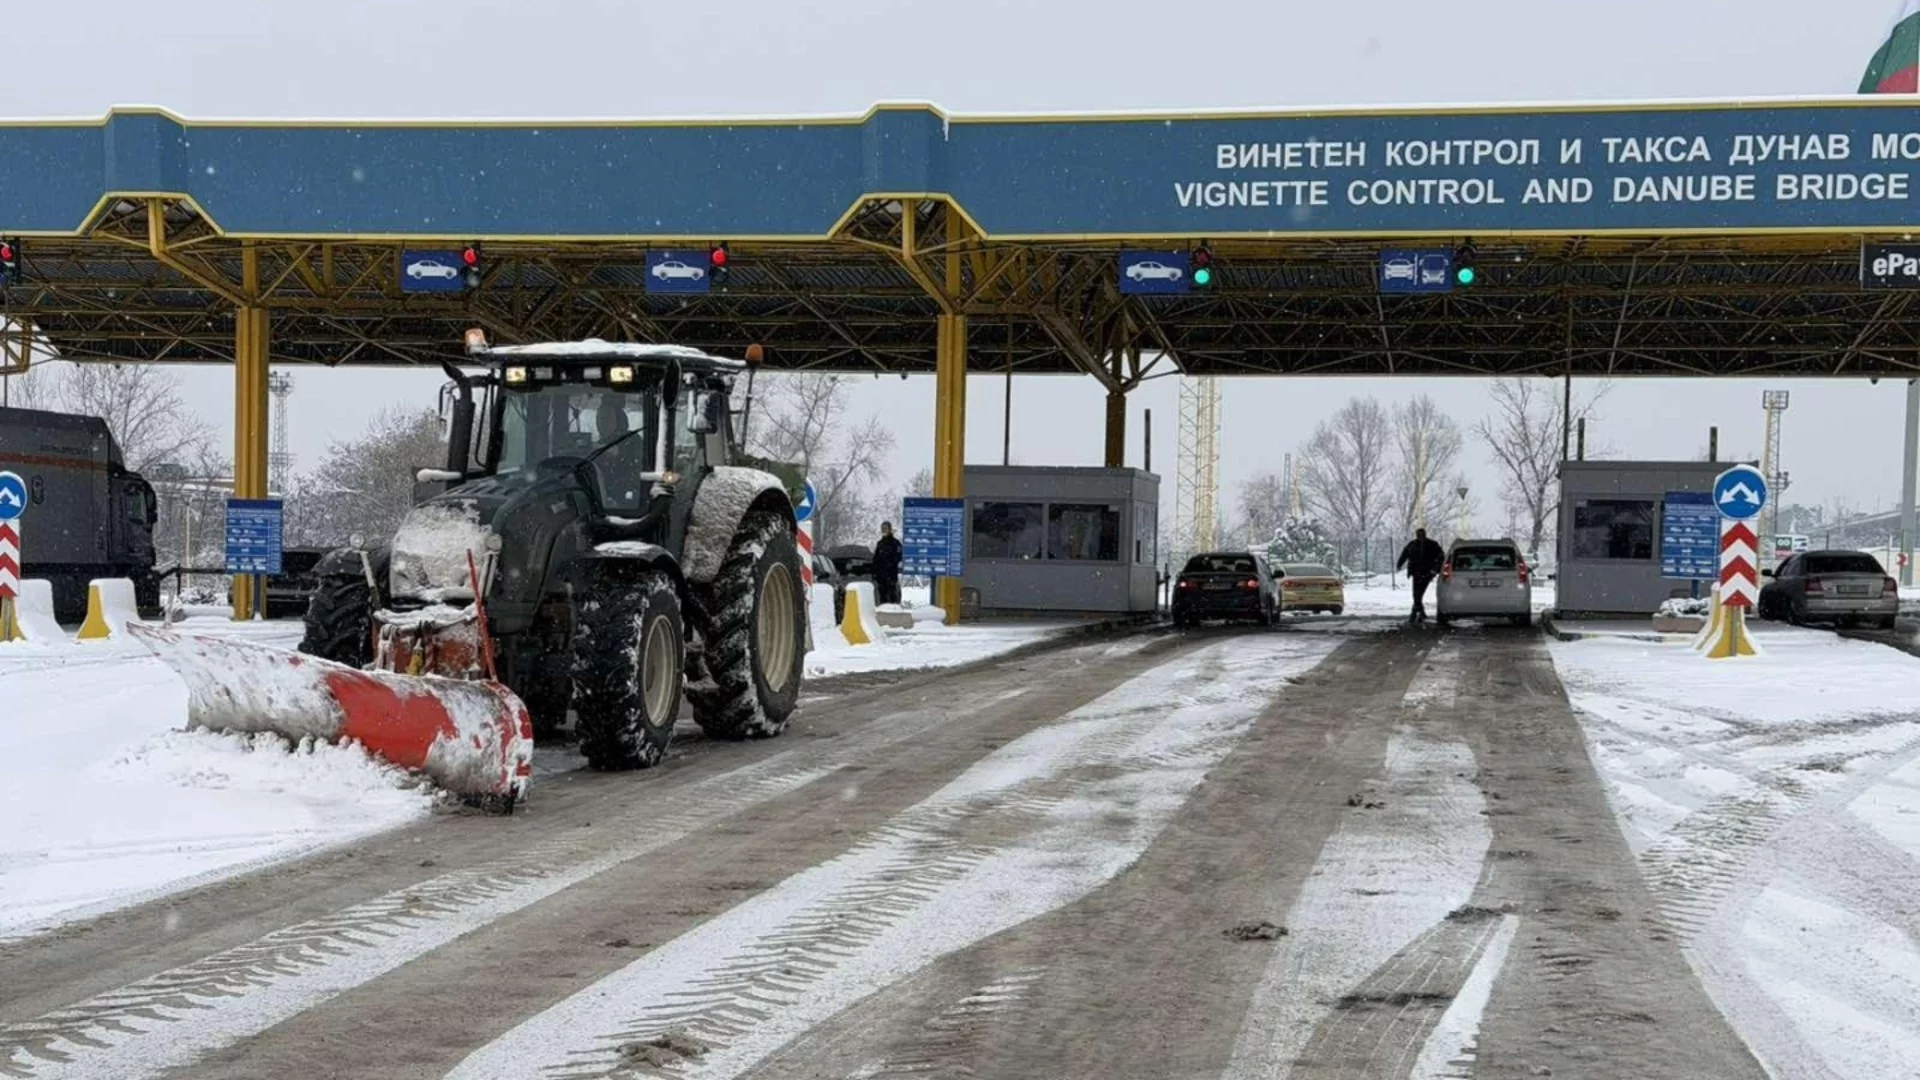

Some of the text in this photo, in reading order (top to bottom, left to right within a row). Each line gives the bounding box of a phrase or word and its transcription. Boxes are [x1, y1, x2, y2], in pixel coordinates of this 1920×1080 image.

[1216, 141, 1367, 169] ВИНЕТЕН
[1386, 139, 1541, 166] КОНТРОЛ
[1560, 138, 1583, 164] И
[1601, 136, 1712, 163] ТАКСА
[1729, 134, 1851, 166] ДУНАВ
[1174, 173, 1910, 207] VIGNETTE CONTROL AND DANUBE BRIDGE
[1872, 253, 1920, 281] ePa
